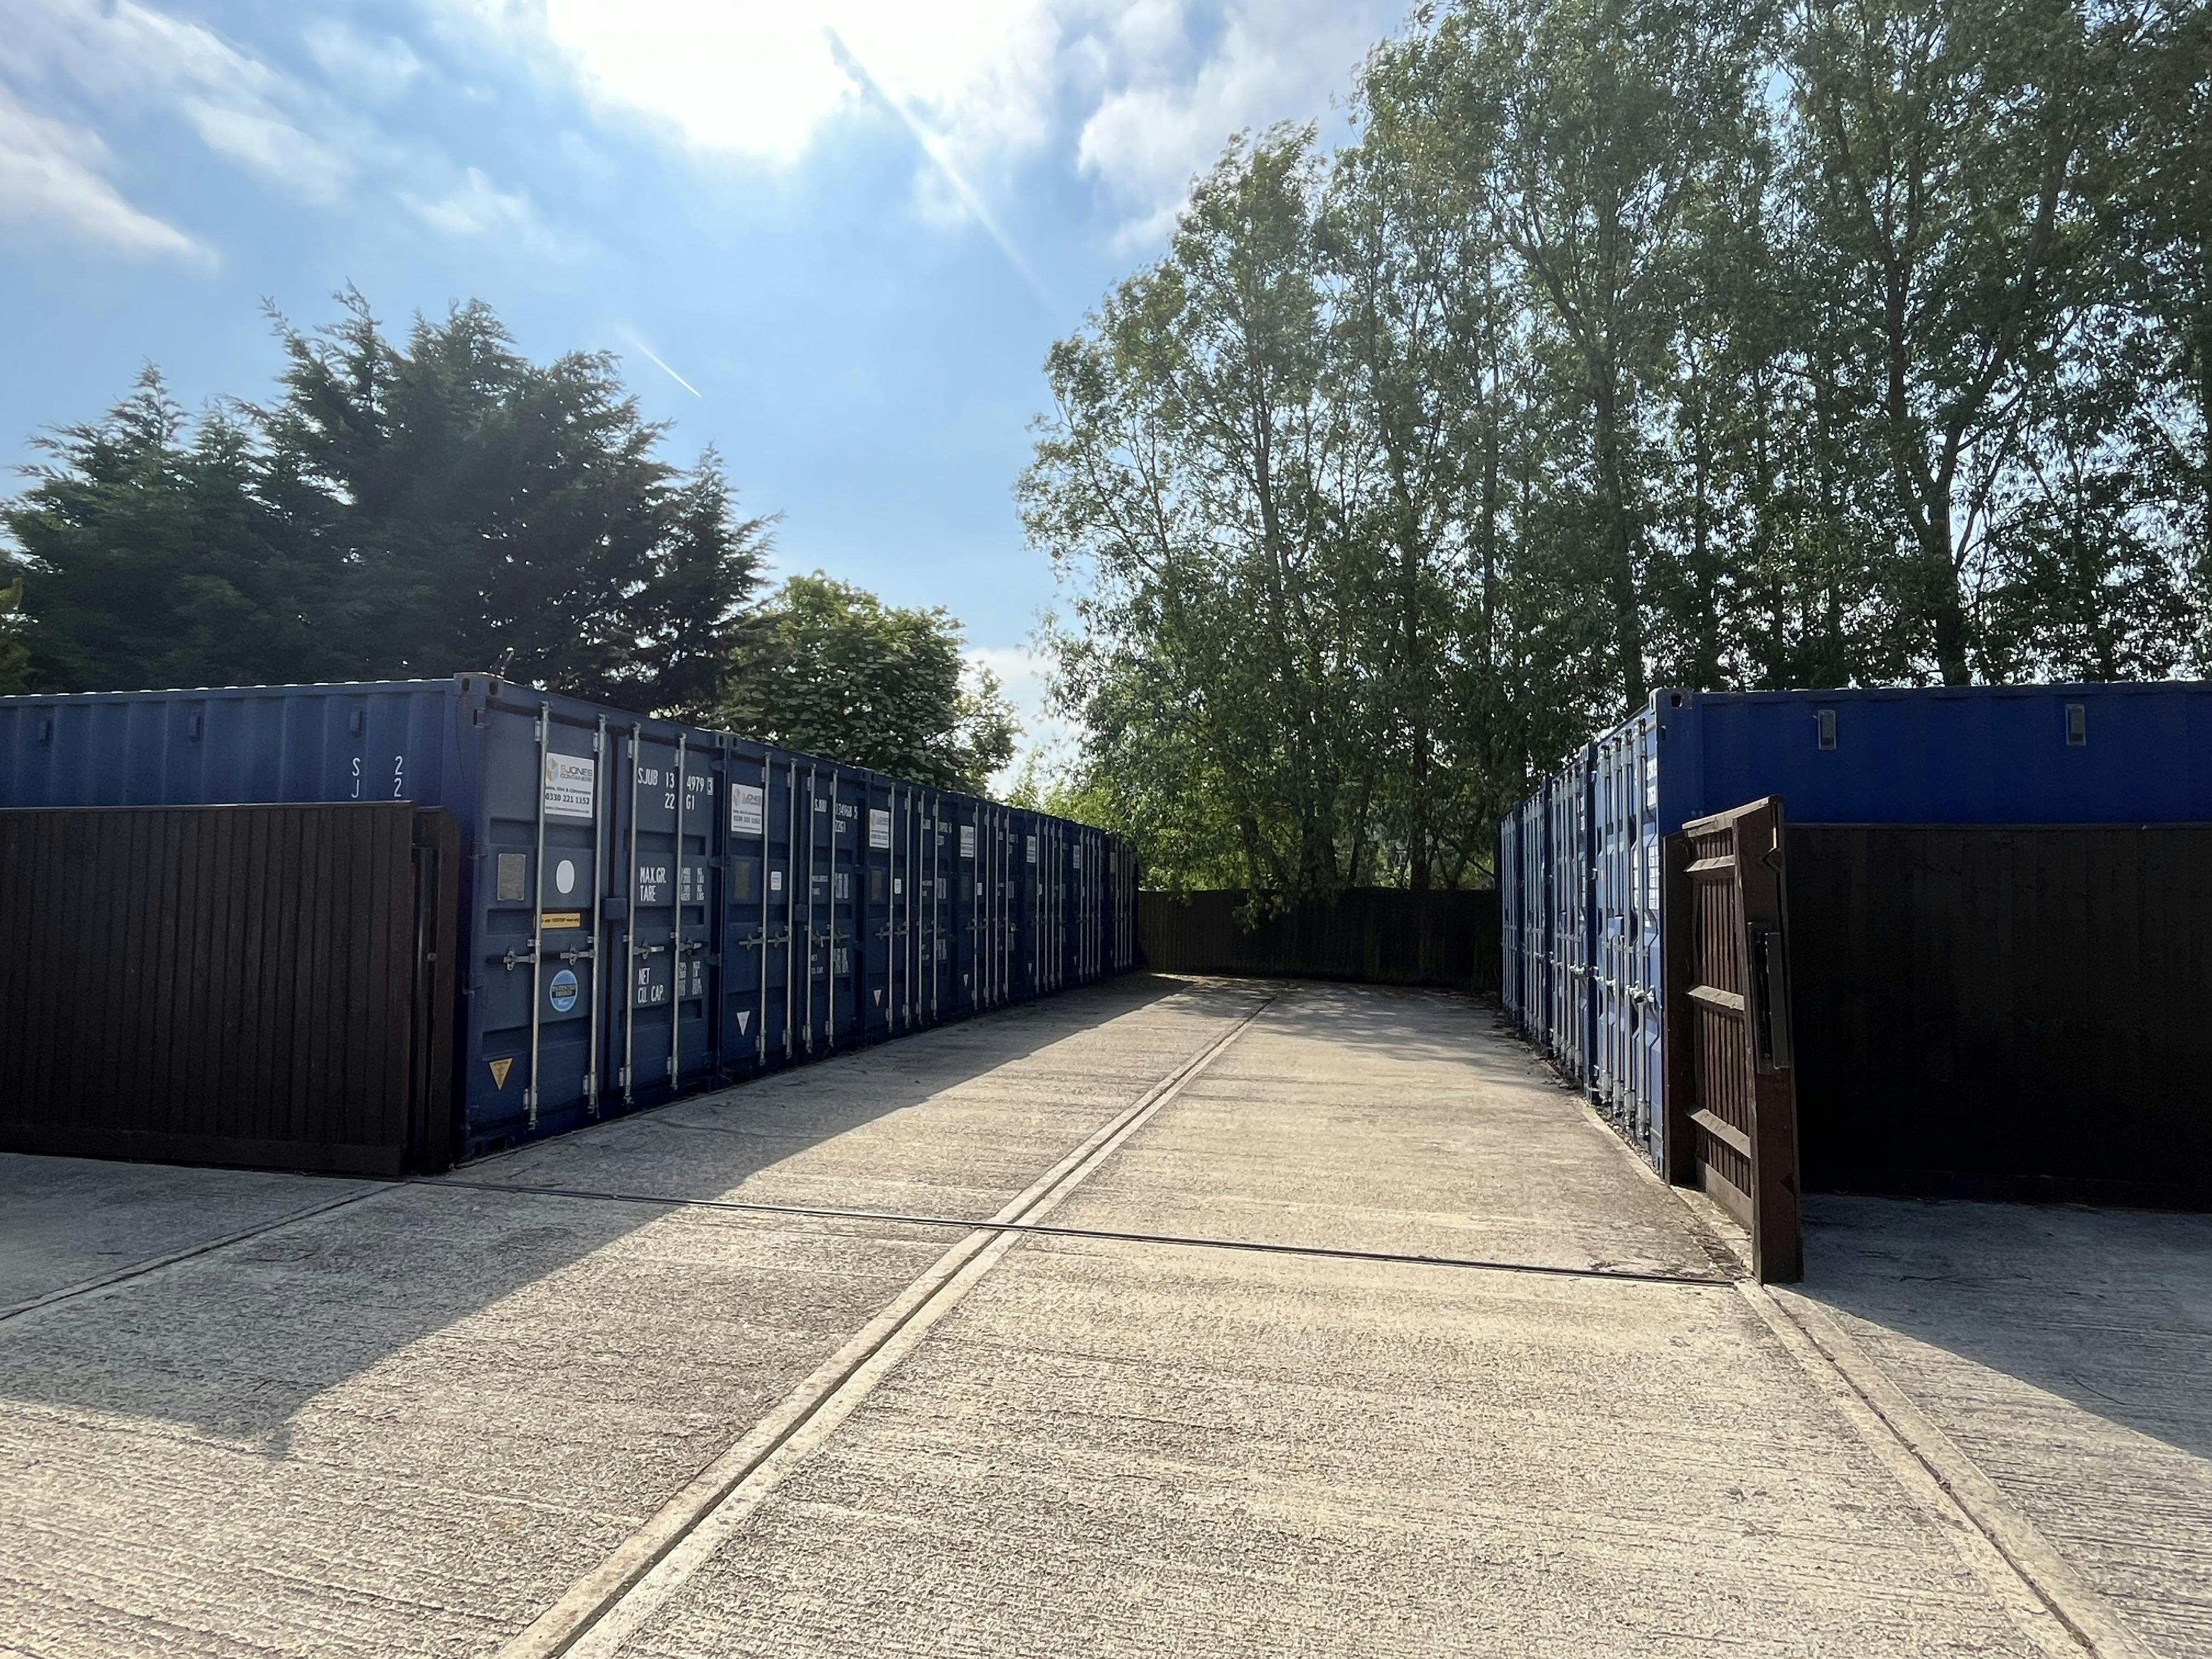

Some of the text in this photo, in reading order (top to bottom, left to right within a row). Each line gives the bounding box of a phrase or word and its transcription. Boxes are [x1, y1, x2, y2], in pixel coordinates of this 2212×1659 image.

[665, 772, 675, 789] 13
[686, 775, 704, 793] 4979
[562, 794, 574, 803] 221
[575, 796, 590, 805] 1152
[665, 792, 675, 810] 22
[640, 885, 657, 902] TARE
[638, 967, 651, 985] NET
